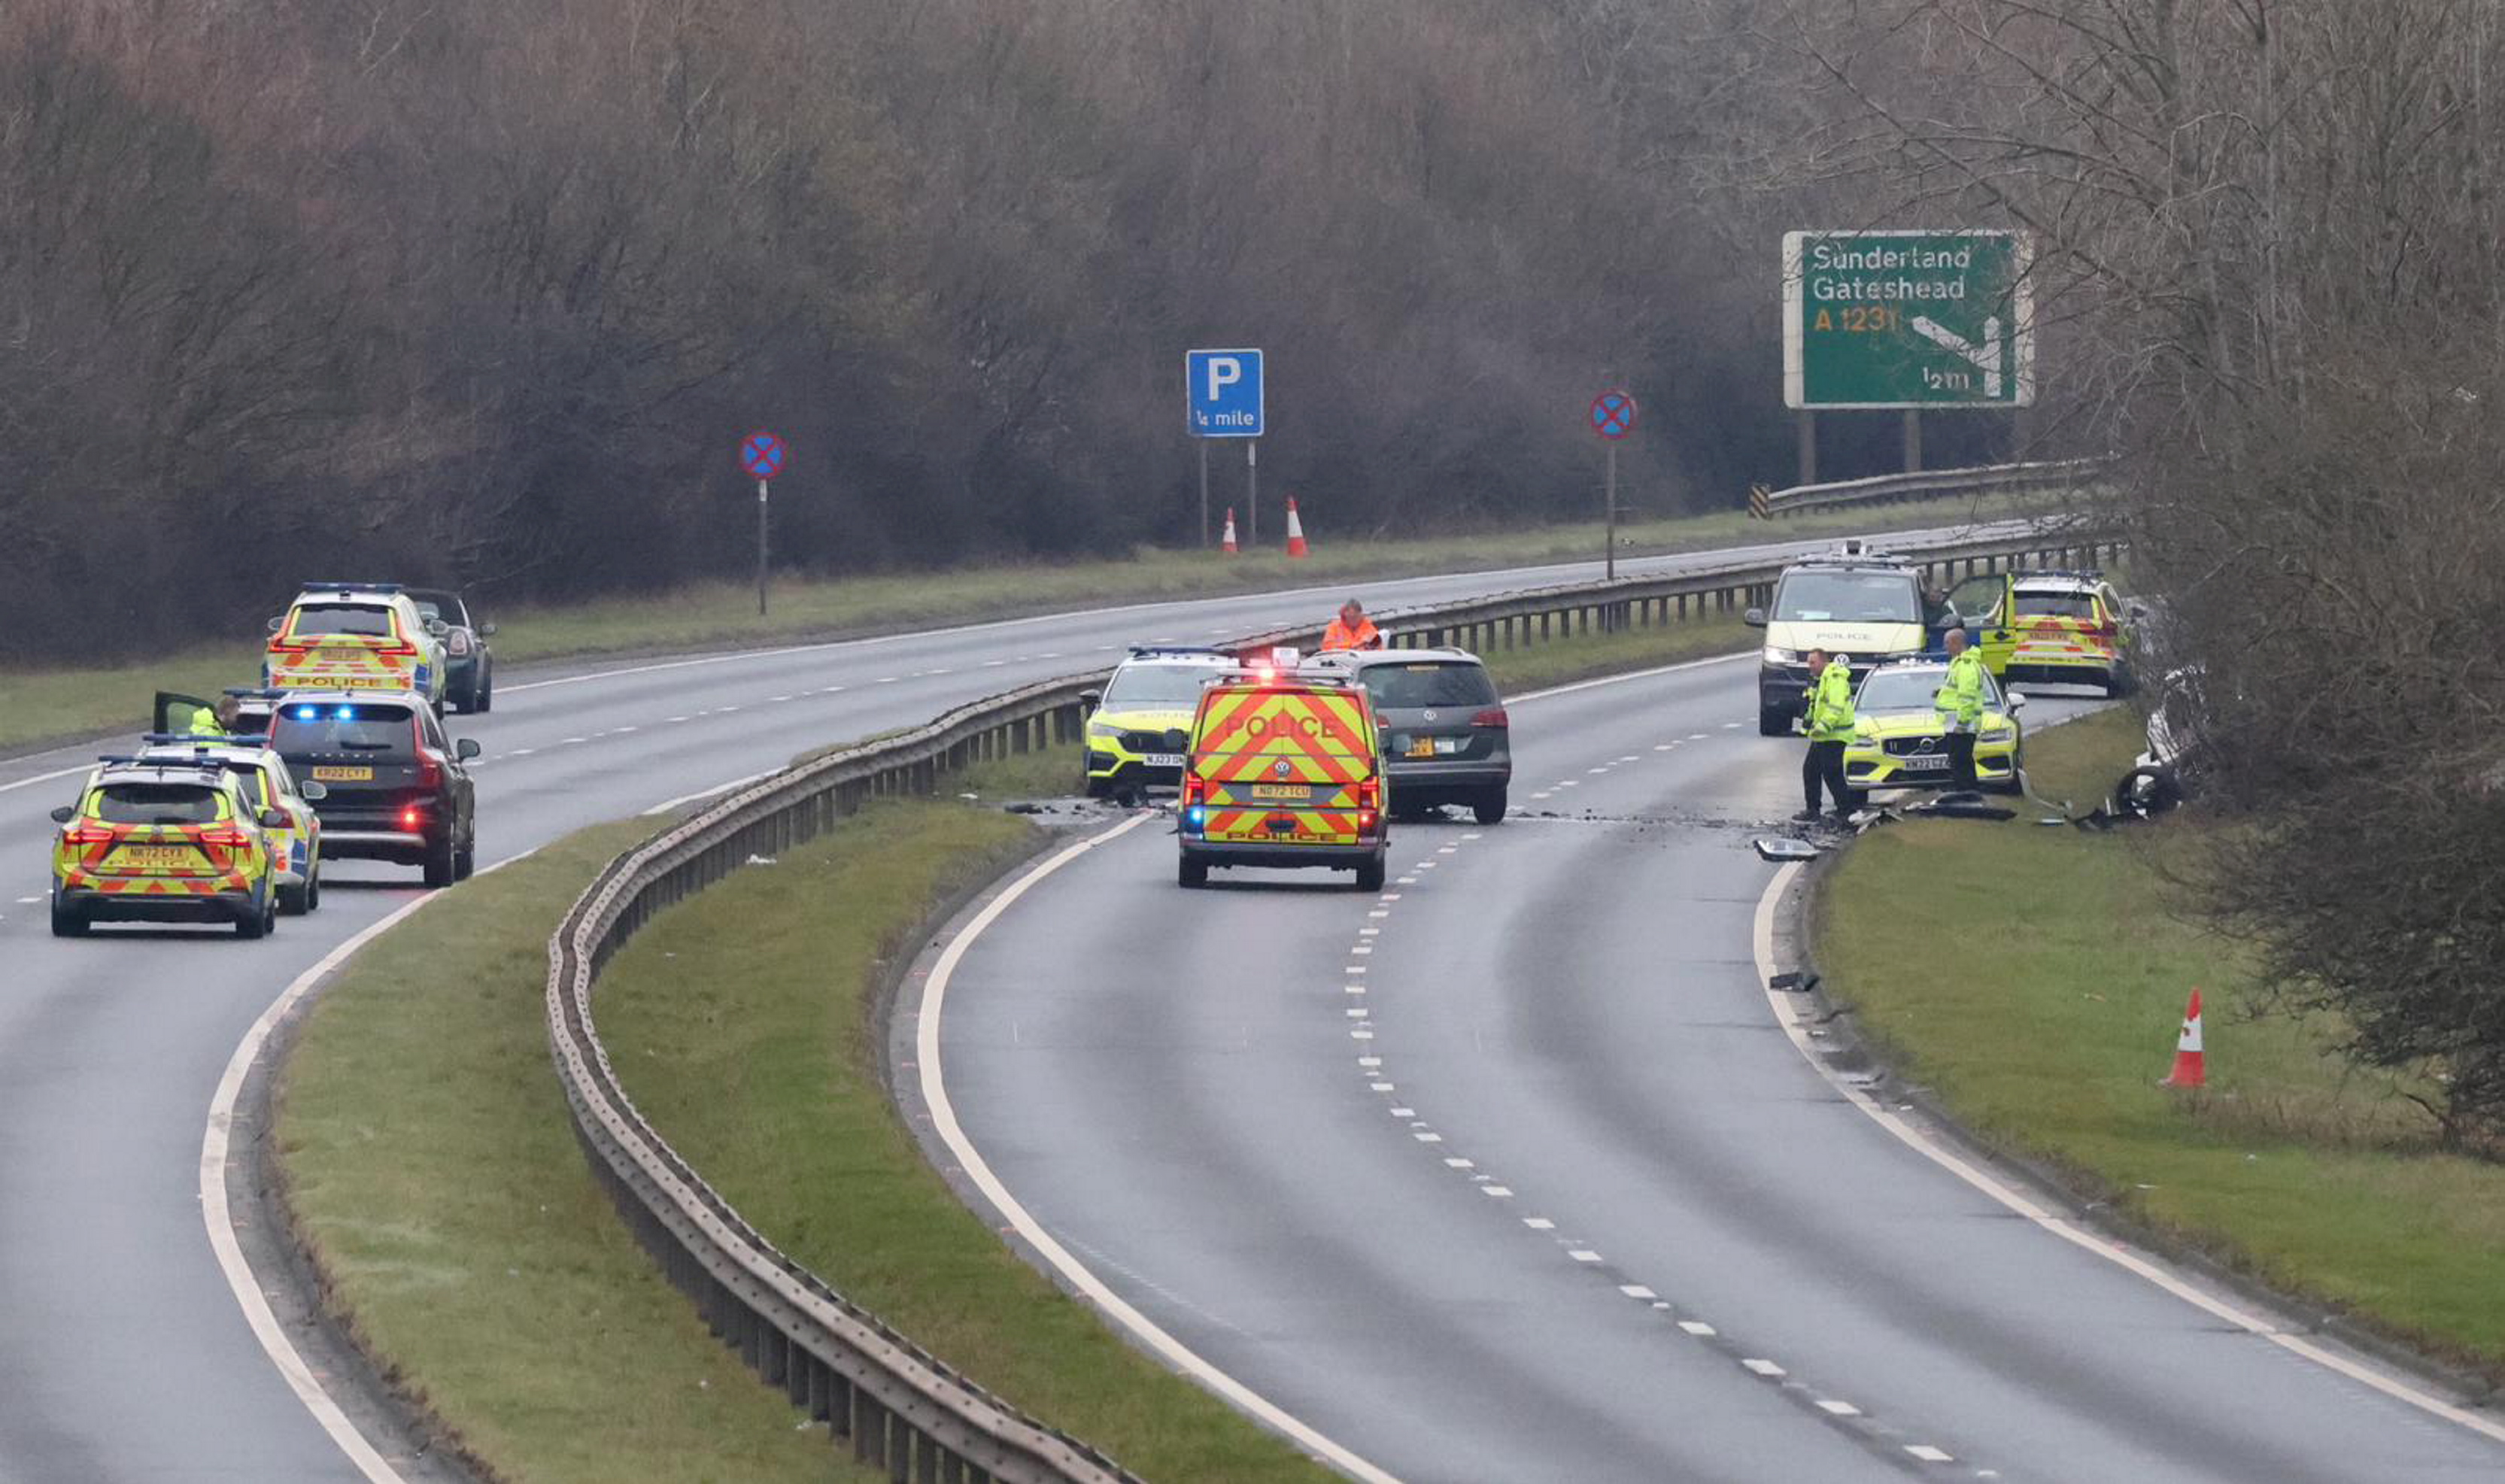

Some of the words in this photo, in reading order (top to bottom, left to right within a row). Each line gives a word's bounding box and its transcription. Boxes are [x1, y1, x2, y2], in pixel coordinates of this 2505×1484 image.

[1814, 245, 1970, 269] Sunderland
[1813, 277, 1965, 300] Gateshead
[1814, 308, 1832, 331] A
[1208, 358, 1241, 401] P
[1215, 410, 1255, 426] mile
[296, 677, 381, 687] POLICE
[1226, 716, 1336, 739] POLICE
[1226, 832, 1338, 841] POLICE
